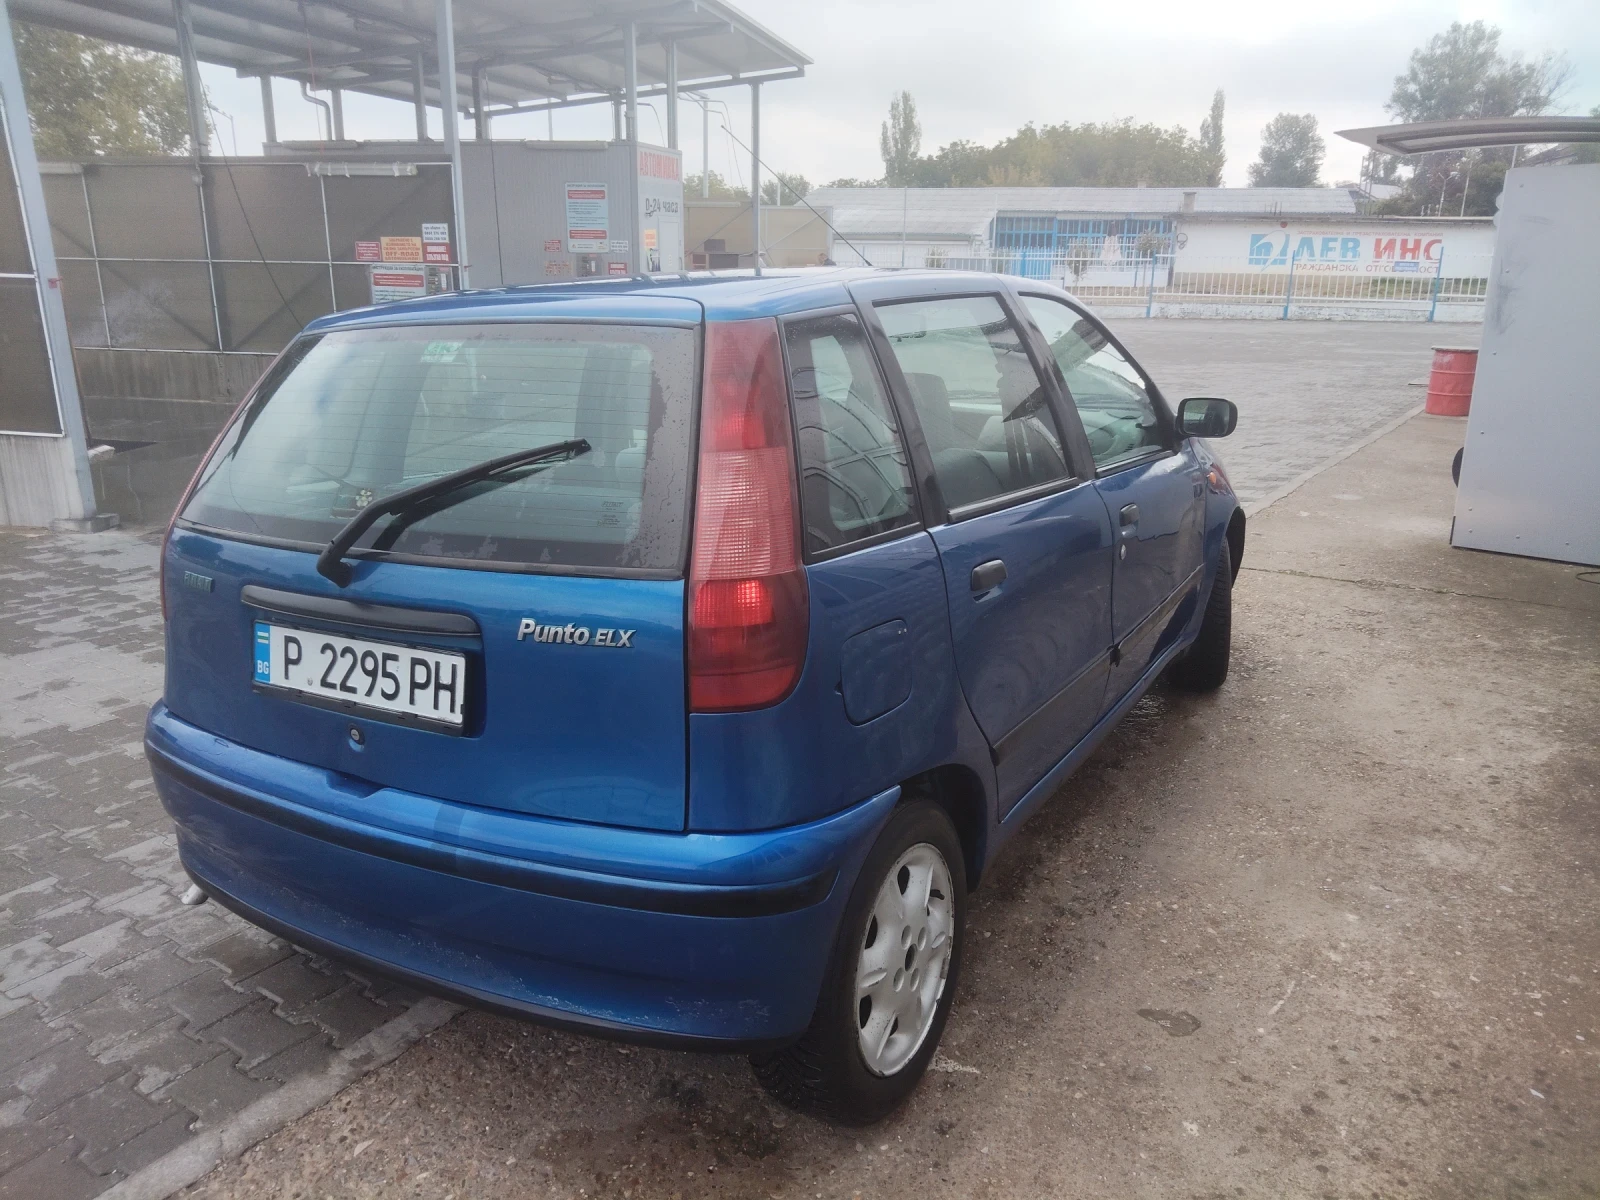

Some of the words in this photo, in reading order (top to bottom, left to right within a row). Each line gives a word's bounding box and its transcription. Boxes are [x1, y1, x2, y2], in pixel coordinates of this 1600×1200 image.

[640, 151, 680, 181] АВТОМИВКА
[645, 198, 661, 213] 0-24
[662, 201, 679, 214] часа
[1295, 236, 1361, 262] ЛЕВ
[1372, 238, 1443, 264] ИНС
[1365, 264, 1439, 273] ОТГООСТ
[517, 617, 590, 646] Punto
[594, 627, 637, 648] ELX
[256, 659, 270, 675] BG
[284, 634, 303, 680] P
[320, 642, 400, 701] 2295
[409, 656, 458, 714] PH
